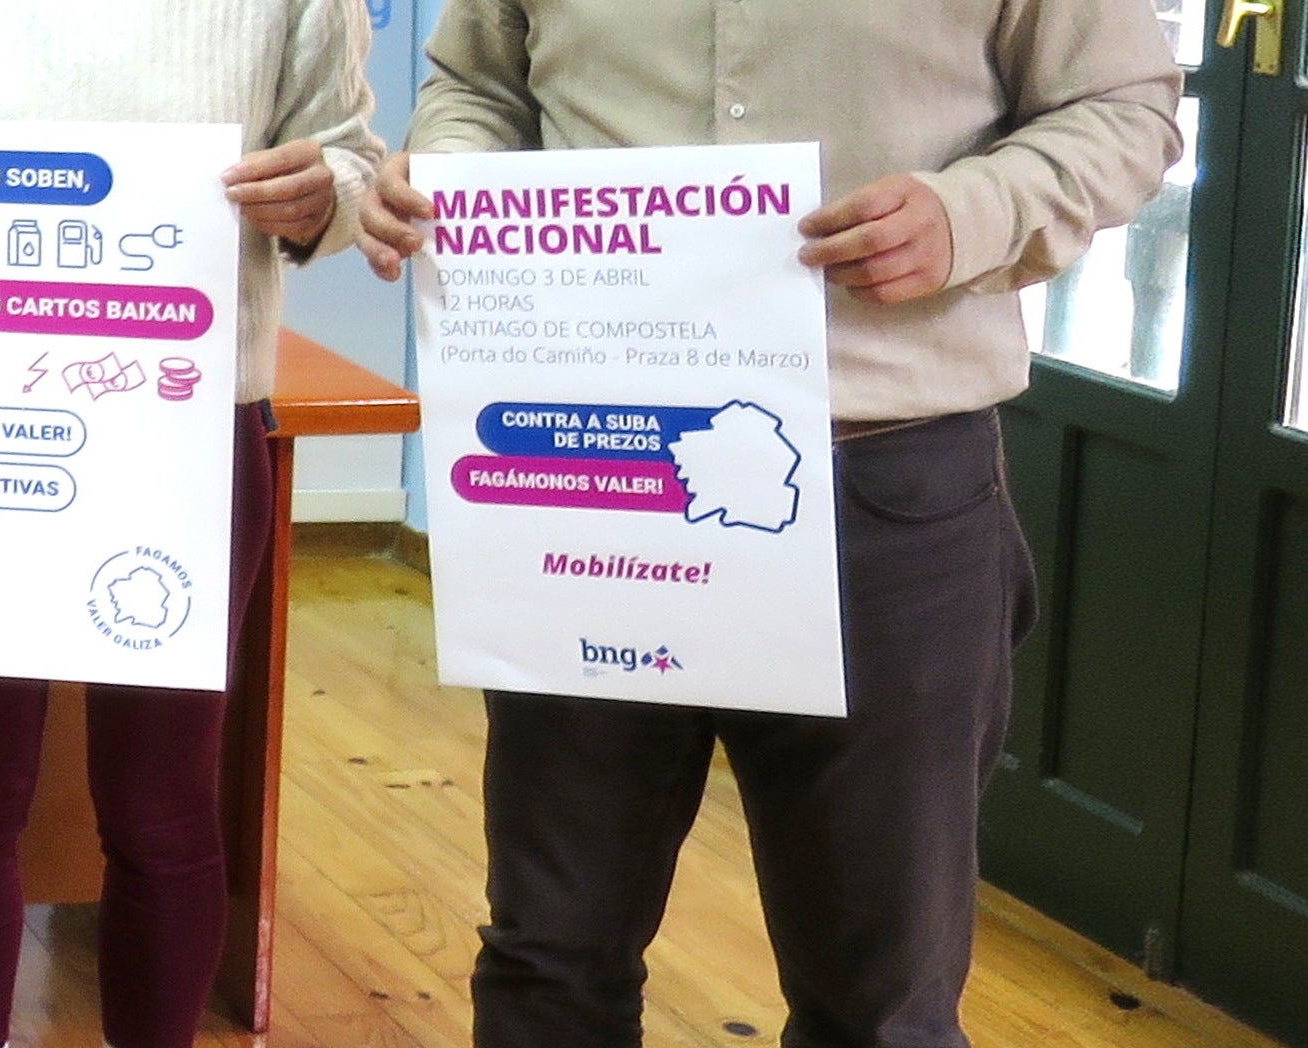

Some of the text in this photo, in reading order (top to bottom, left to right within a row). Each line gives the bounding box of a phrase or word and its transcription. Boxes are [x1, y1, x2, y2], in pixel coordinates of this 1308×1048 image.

[6, 169, 90, 193] SOBEN,
[433, 175, 791, 221] MANIFESTACIÓN
[435, 223, 663, 256] NACIONAL
[438, 268, 650, 287] DOMINGO 3 DE ABRIL
[6, 296, 100, 319] CARTOS
[106, 300, 196, 323] BAIXAN
[440, 294, 535, 312] 12 HORAS
[439, 319, 717, 340] SANTIAGO DE COMPOSTELA
[441, 345, 497, 365] (Porta
[502, 345, 526, 364] do
[532, 346, 607, 365] Camiño
[626, 349, 681, 367] Praza
[686, 350, 699, 366] 8
[705, 349, 731, 368] de
[737, 350, 809, 370] Marzo)
[1, 423, 72, 442] VALER!
[501, 410, 661, 431] CONTRA A SUBA
[554, 432, 661, 451] DE PREZOS
[469, 467, 663, 496] FAGÁMONOS VALER!
[541, 552, 712, 584] Mobilízate!
[579, 637, 636, 671] bng
